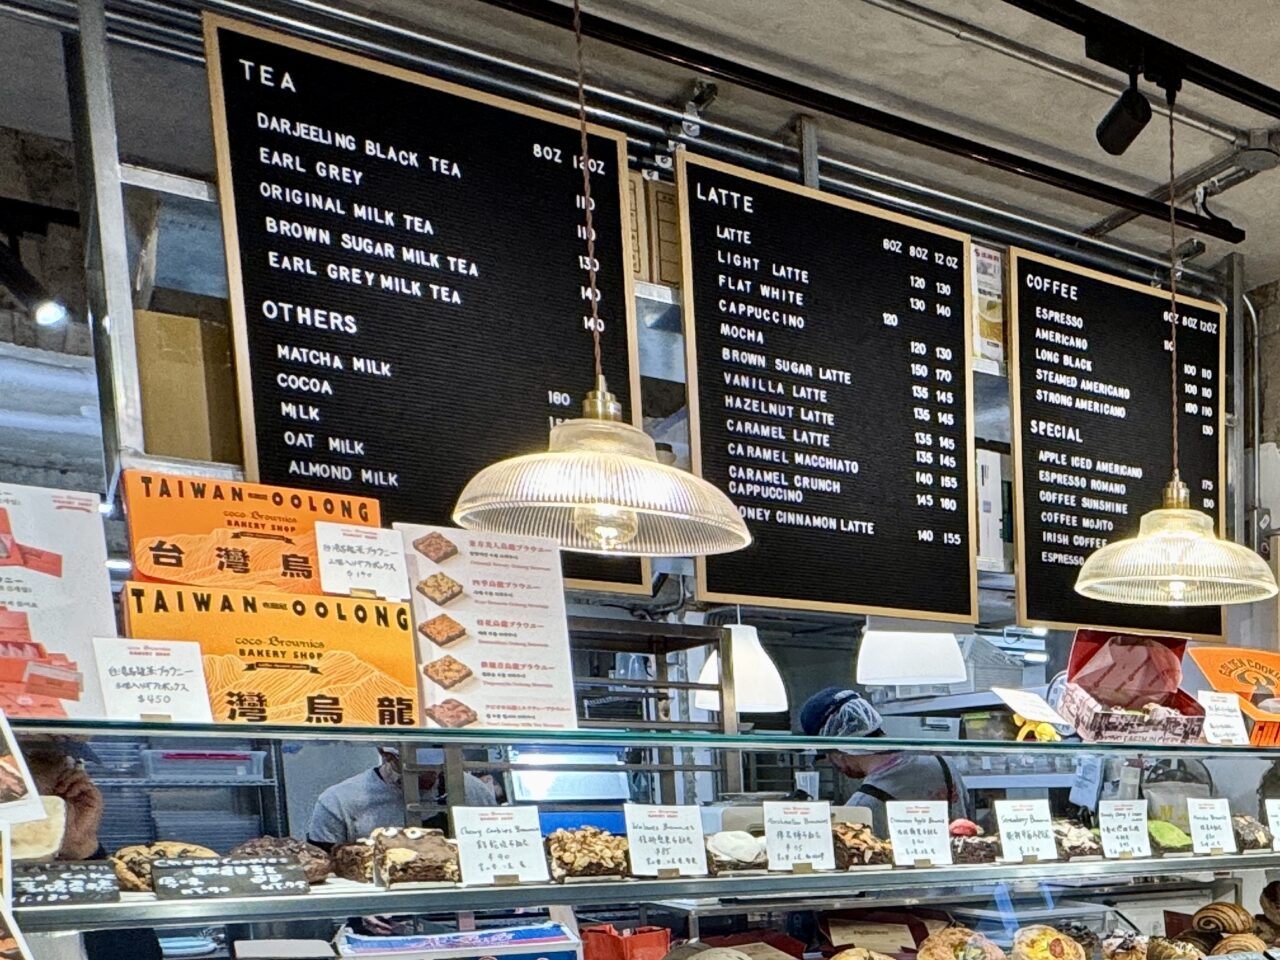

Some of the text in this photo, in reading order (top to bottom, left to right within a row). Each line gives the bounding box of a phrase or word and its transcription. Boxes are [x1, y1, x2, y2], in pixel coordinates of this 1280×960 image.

[239, 58, 296, 93] TEA
[257, 112, 356, 151] DARJEELING
[365, 139, 419, 168] BLACK
[429, 156, 462, 179] TEA
[259, 147, 306, 173] EARL
[316, 161, 363, 186] GREY
[259, 182, 346, 215] ORIGINAL
[354, 203, 395, 227] MILK
[403, 215, 434, 236] TEA
[697, 182, 754, 214] LATTE
[265, 217, 331, 246] BROWN
[341, 233, 395, 259] SUGAR
[402, 247, 440, 269] MILK
[447, 257, 479, 278] TEA
[716, 224, 951, 296] LATTE 120 130
[268, 251, 317, 275] EARL
[327, 264, 375, 287] GREY
[380, 274, 421, 297] MILK
[429, 284, 462, 305] TEA
[718, 250, 951, 318] LIGHT LATTE 130 140
[1026, 273, 1078, 301] COFFEE
[262, 300, 358, 334] OTHERS
[718, 274, 898, 327] FLAT WHITE 120
[1035, 306, 1084, 329] ESPRESSO
[718, 299, 952, 361] CAPPUCCINO 120 130
[1035, 327, 1088, 350] AMERICANO
[277, 344, 392, 377] MATCHA MILK
[720, 322, 952, 383] MOCHA 150 170
[1035, 347, 1060, 364] LONG
[1063, 354, 1093, 372] BLACK
[277, 373, 333, 395] COCOA
[722, 347, 954, 404] BROWN SUGAR LATTE 135 145
[1035, 368, 1078, 388] STEAMED
[1080, 379, 1131, 399] AMERICANO
[281, 402, 320, 422] MILK
[723, 371, 955, 426] VANILLA LATTE 135 145
[1035, 389, 1126, 419] STRONG AMERICANO
[725, 394, 956, 450] HAZELNUT LATTE 135 145
[1030, 419, 1083, 443] SPECIAL
[284, 430, 365, 456] OAT MILK
[726, 419, 956, 468] CARAMEL LATTE 135 145
[288, 461, 399, 487] ALMOND MILK
[727, 443, 958, 489] CARAMEL MACCHIATO 140 155
[1038, 450, 1143, 479] APPLE ICED AMERICANO
[141, 475, 369, 523] TAIWAN OOLONG
[728, 465, 933, 508] CARAMEL CRUNCH 145
[728, 482, 803, 504] CAPPUCCINO
[1038, 470, 1126, 495] ESPRESSO ROMANO
[1039, 490, 1129, 515] COFFEE SUNSHINE
[226, 519, 297, 534] BAKERY SHOP
[740, 506, 962, 545] ONEY CINNAMON LATTE 140 155
[1041, 511, 1114, 532] COFFEE MOJITO
[1042, 530, 1108, 549] IRISH COFFEE
[148, 540, 313, 580] 台灣烏
[1041, 551, 1085, 567] ESPRESSO
[131, 588, 409, 631] TAIWAN OOLONG
[238, 648, 324, 661] BAKERY SHOP
[225, 690, 416, 727] 灣烏龍
